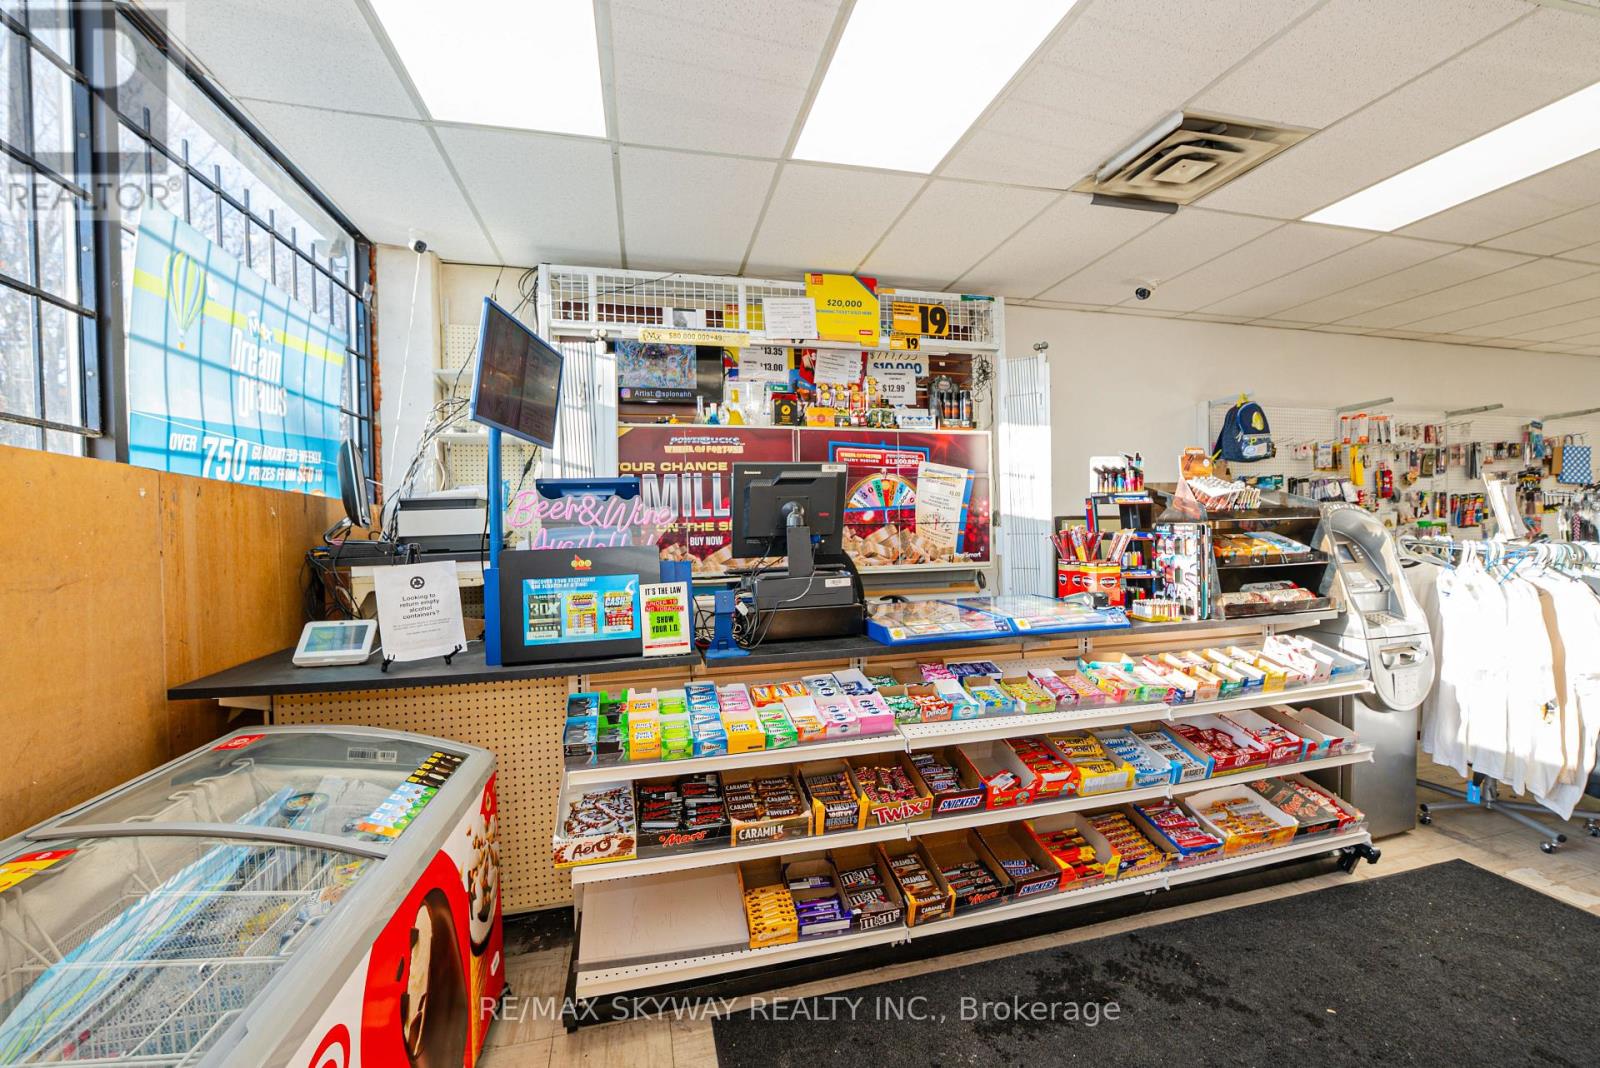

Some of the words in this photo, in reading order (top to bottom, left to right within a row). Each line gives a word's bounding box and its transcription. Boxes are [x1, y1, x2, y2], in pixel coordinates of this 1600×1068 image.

[827, 299, 862, 308] $20,000
[919, 305, 947, 334] 19
[906, 337, 919, 350] 19
[230, 327, 282, 383] Dream
[873, 362, 923, 375] $10000
[882, 384, 906, 393] $12.99
[238, 376, 288, 418] Draws
[169, 432, 197, 452] OVER
[202, 436, 249, 482] 750
[618, 462, 655, 472] OUR
[660, 462, 728, 472] CHANCE
[249, 466, 276, 481] PRIZES
[641, 473, 733, 518] MILL
[687, 522, 714, 532] THE
[689, 536, 704, 546] BUY
[705, 536, 724, 546] NOW
[658, 587, 668, 595] THE
[669, 586, 682, 594] LAW
[402, 594, 428, 602] Looking
[402, 609, 440, 619] containers?
[409, 605, 433, 613] alcohol
[530, 602, 561, 616] 30X
[656, 616, 674, 624] SHOW
[652, 625, 667, 633] YOUR
[725, 783, 752, 791] CARAMILK
[729, 803, 758, 811] CARAMILK
[943, 794, 981, 810] SNICKERS
[872, 801, 921, 825] Twix
[738, 824, 784, 840] CARAMILK
[662, 830, 707, 848] Mars
[891, 857, 917, 867] ARAMILK
[1022, 880, 1058, 894] SNICKERS
[921, 903, 946, 914] CARAMILK
